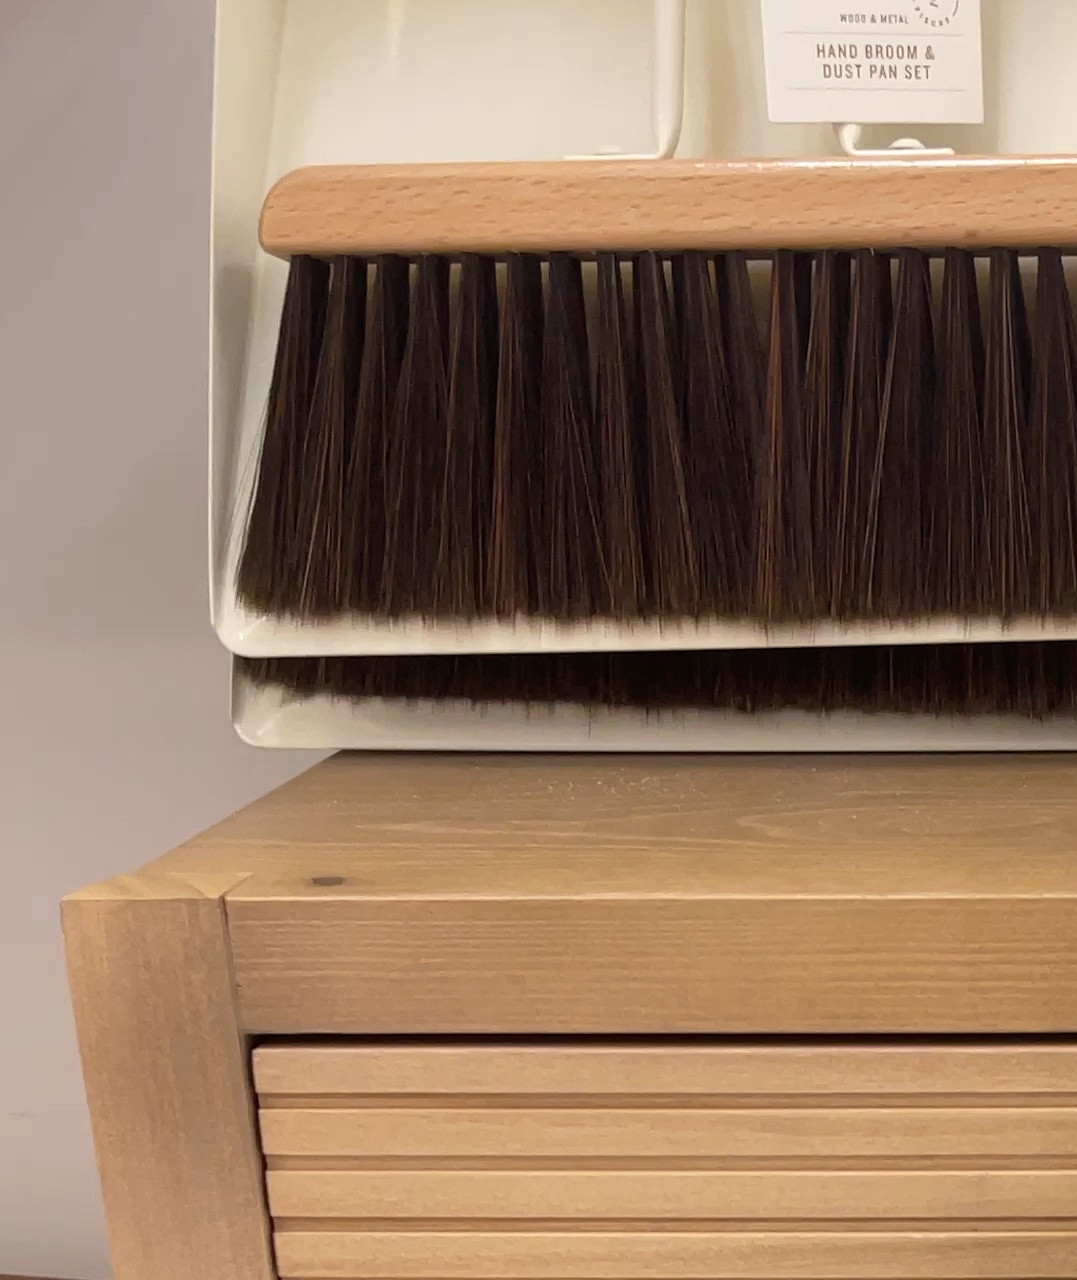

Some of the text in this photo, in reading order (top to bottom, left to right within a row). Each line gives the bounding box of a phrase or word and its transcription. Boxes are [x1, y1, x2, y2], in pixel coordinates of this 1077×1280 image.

[839, 13, 909, 25] WOOD & METAL
[816, 43, 936, 60] HAND BROOM &
[823, 63, 932, 80] DUST PAN SET
